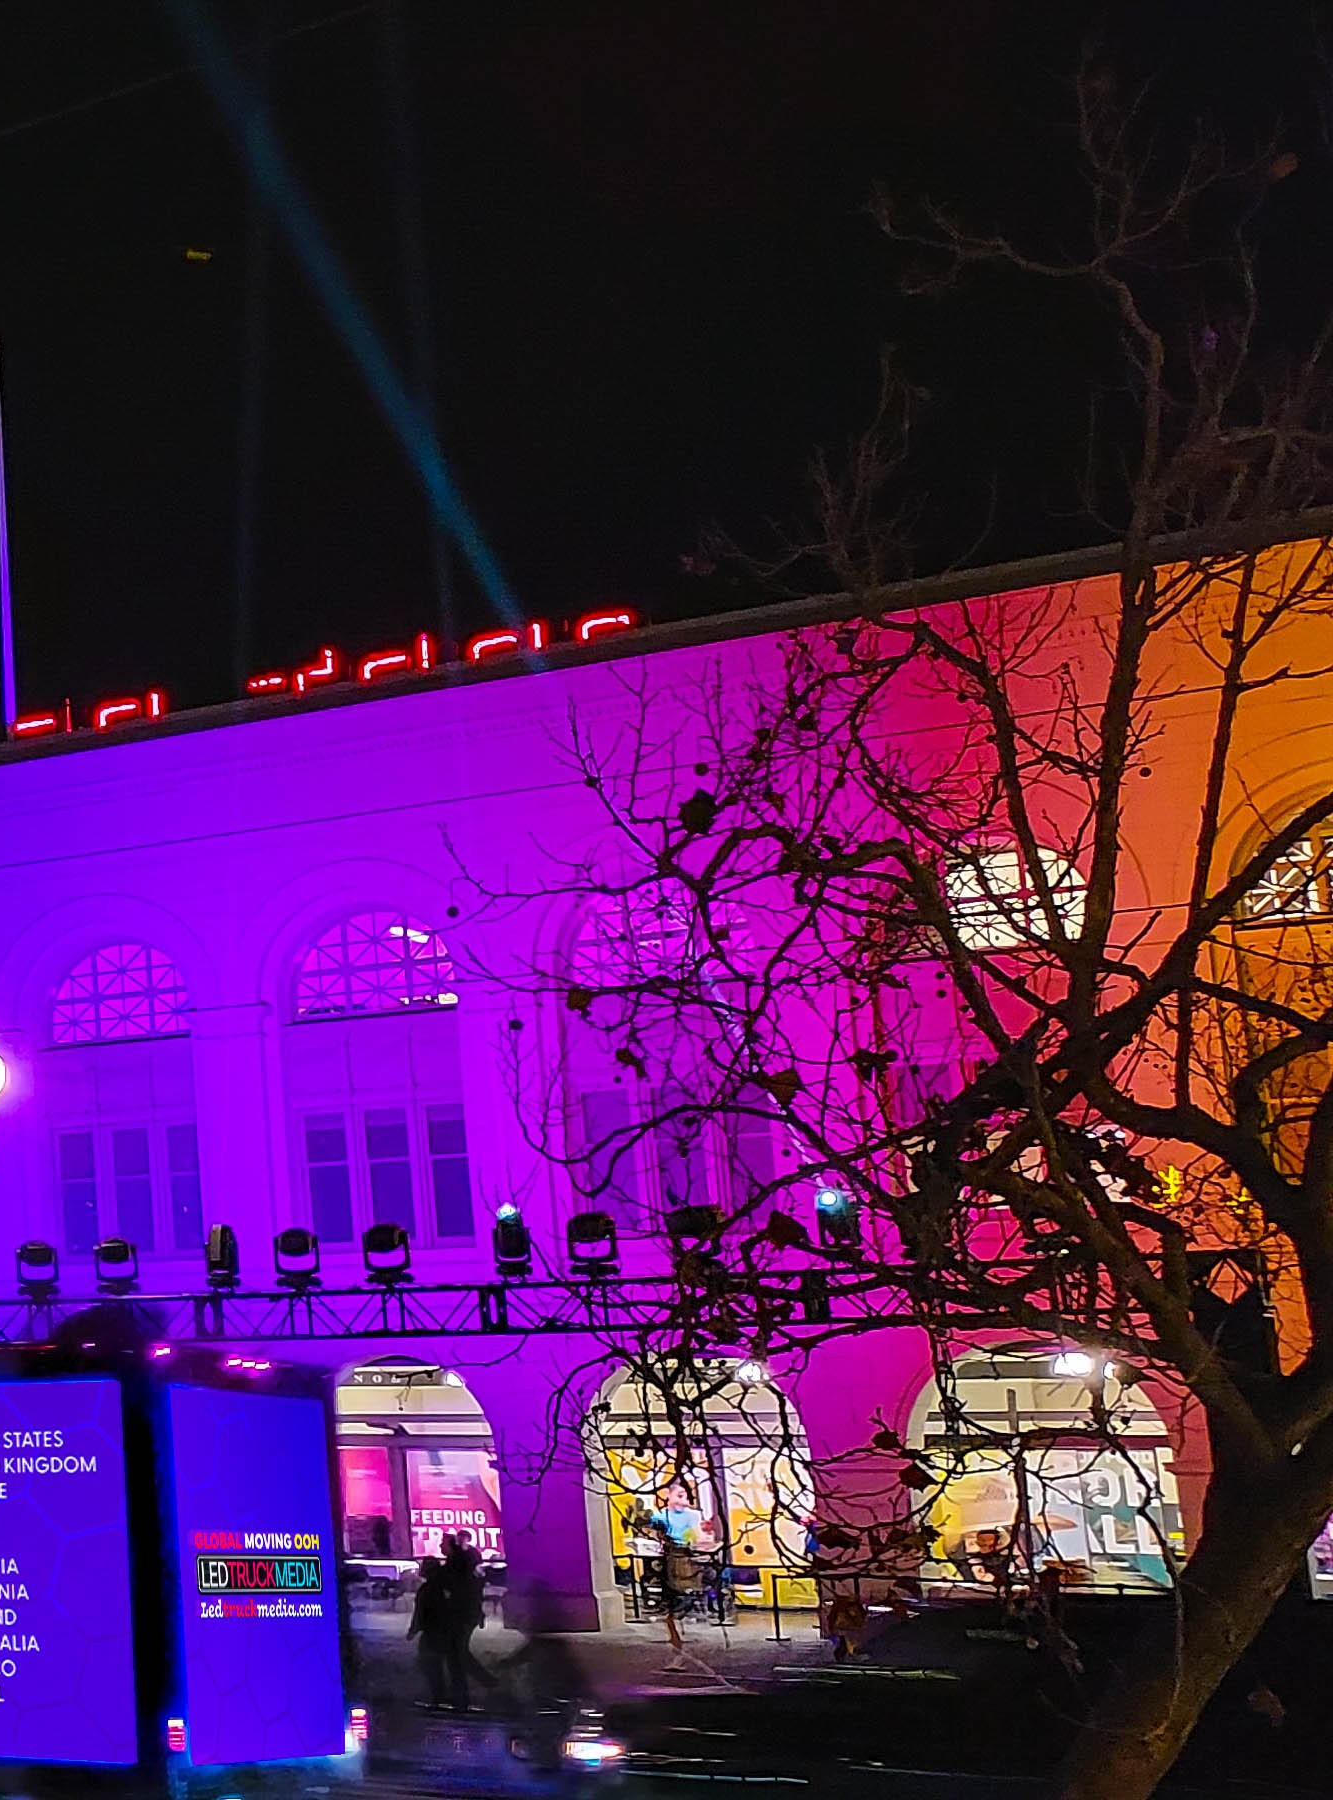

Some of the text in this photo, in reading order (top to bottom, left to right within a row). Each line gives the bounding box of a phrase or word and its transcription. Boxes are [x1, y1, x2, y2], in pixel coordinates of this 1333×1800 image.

[3, 1430, 63, 1448] STATES
[4, 1455, 97, 1473] KINGDOM
[410, 1509, 486, 1525] FEEDING
[195, 1532, 320, 1549] GLOBAL MOVING OOH
[412, 1527, 501, 1549] TRDIT
[201, 1561, 319, 1588] LEDTRUCKMEDIA
